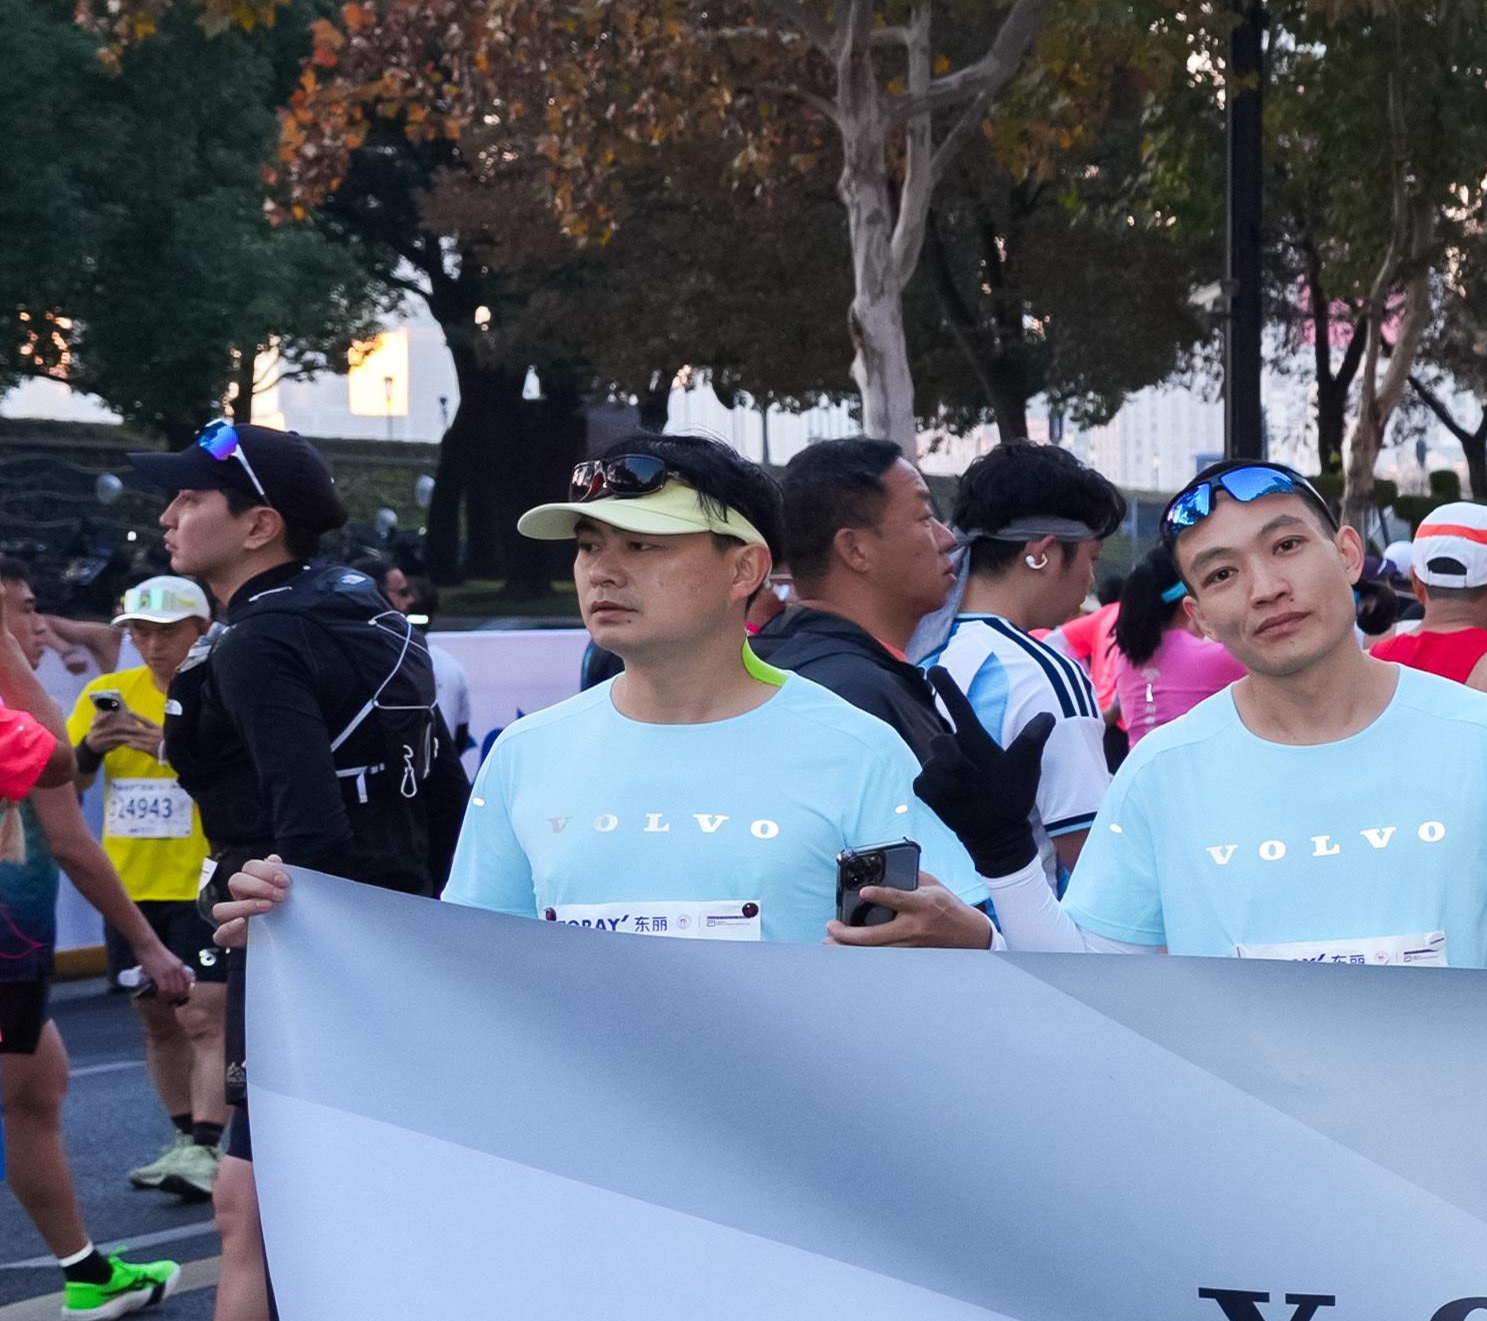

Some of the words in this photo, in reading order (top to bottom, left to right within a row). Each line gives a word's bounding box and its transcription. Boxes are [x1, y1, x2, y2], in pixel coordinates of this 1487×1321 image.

[548, 813, 779, 838] VOLVO
[1206, 821, 1446, 865] VOLVO
[634, 916, 668, 932] 东丽
